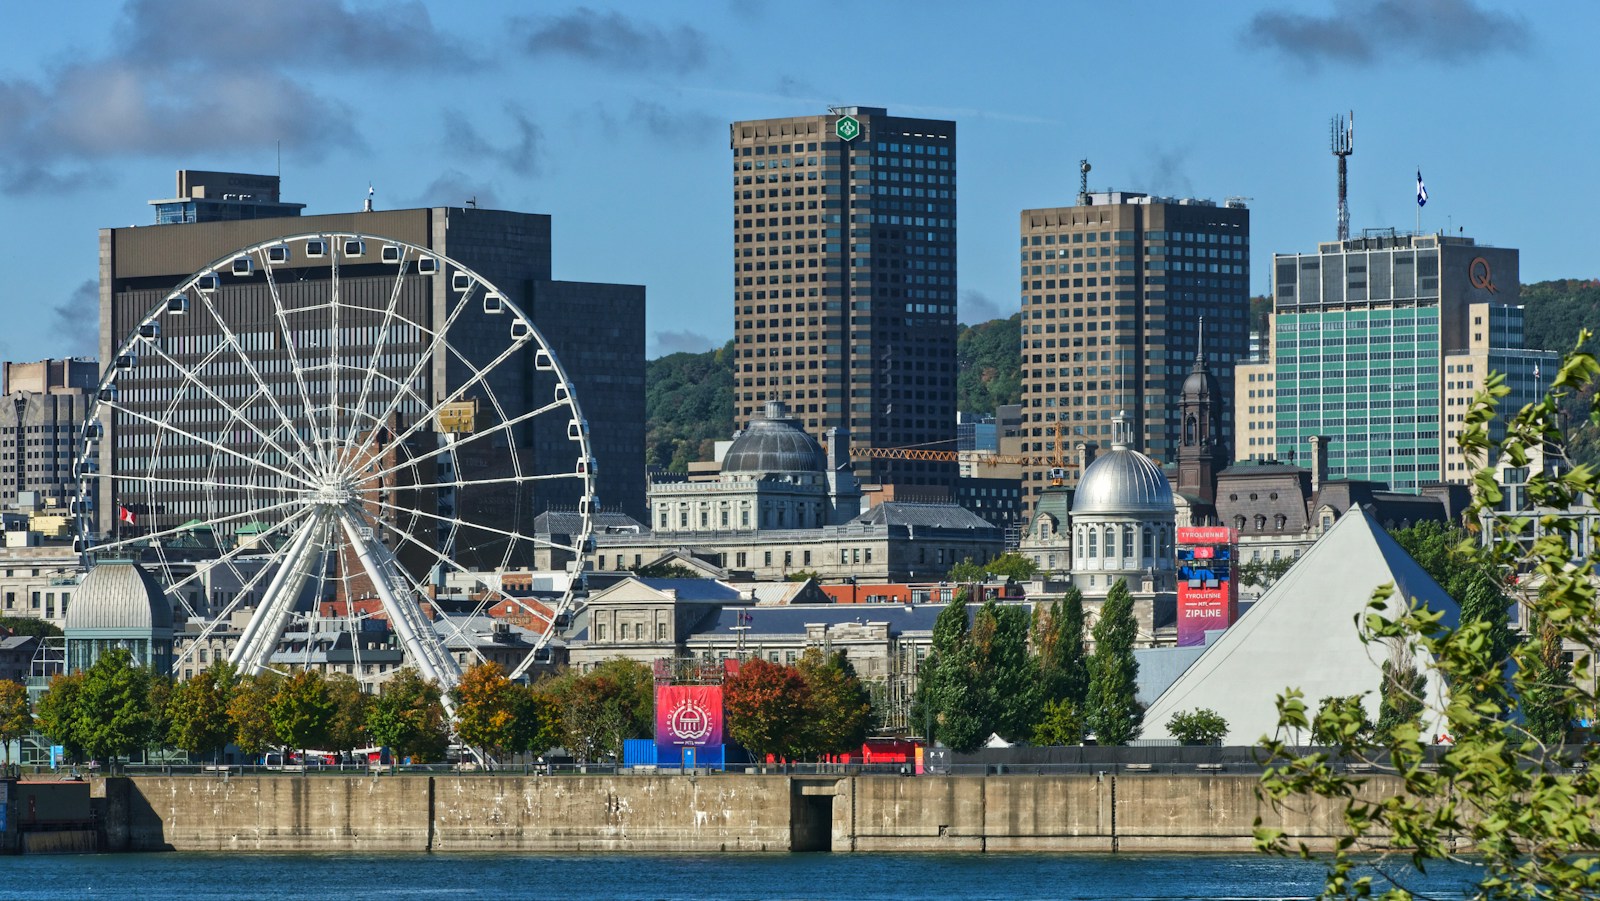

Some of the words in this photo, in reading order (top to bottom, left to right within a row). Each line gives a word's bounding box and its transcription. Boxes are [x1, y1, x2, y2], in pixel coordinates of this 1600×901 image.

[1469, 257, 1499, 295] Q
[1185, 609, 1221, 618] ZIPLINE
[666, 699, 698, 736] TYROLIENNE
[702, 705, 713, 737] ZIPLINE
